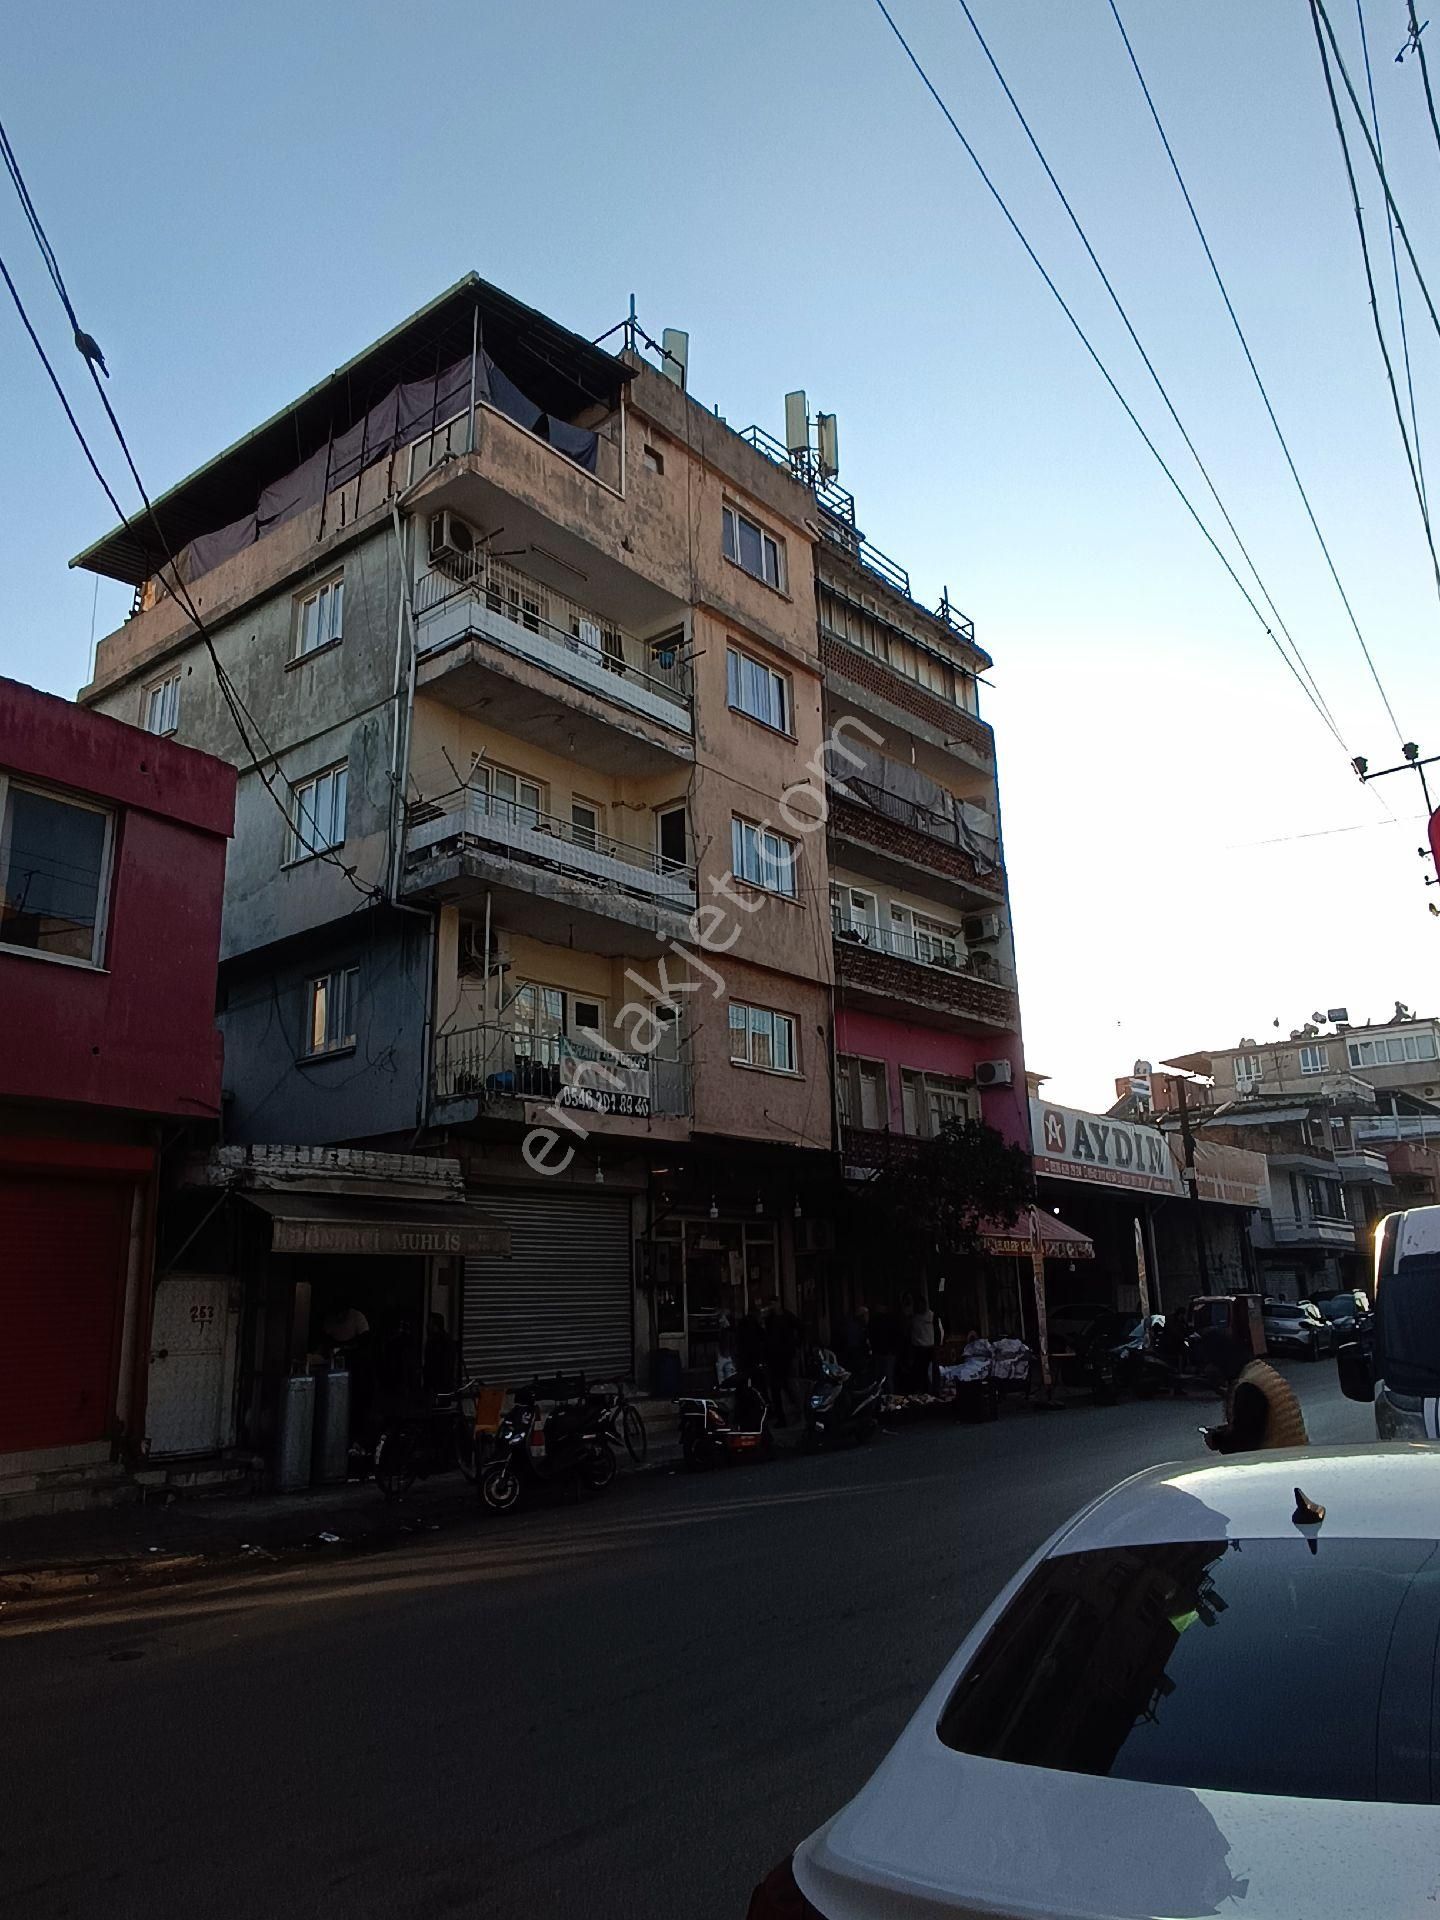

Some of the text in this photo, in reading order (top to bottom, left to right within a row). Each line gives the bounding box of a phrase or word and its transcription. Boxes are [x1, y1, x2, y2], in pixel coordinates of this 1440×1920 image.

[563, 1085, 649, 1117] 0546 201 89 40
[1072, 1118, 1164, 1176] AYDIN
[393, 1231, 461, 1251] MUHLİS
[190, 1305, 214, 1319] 253
